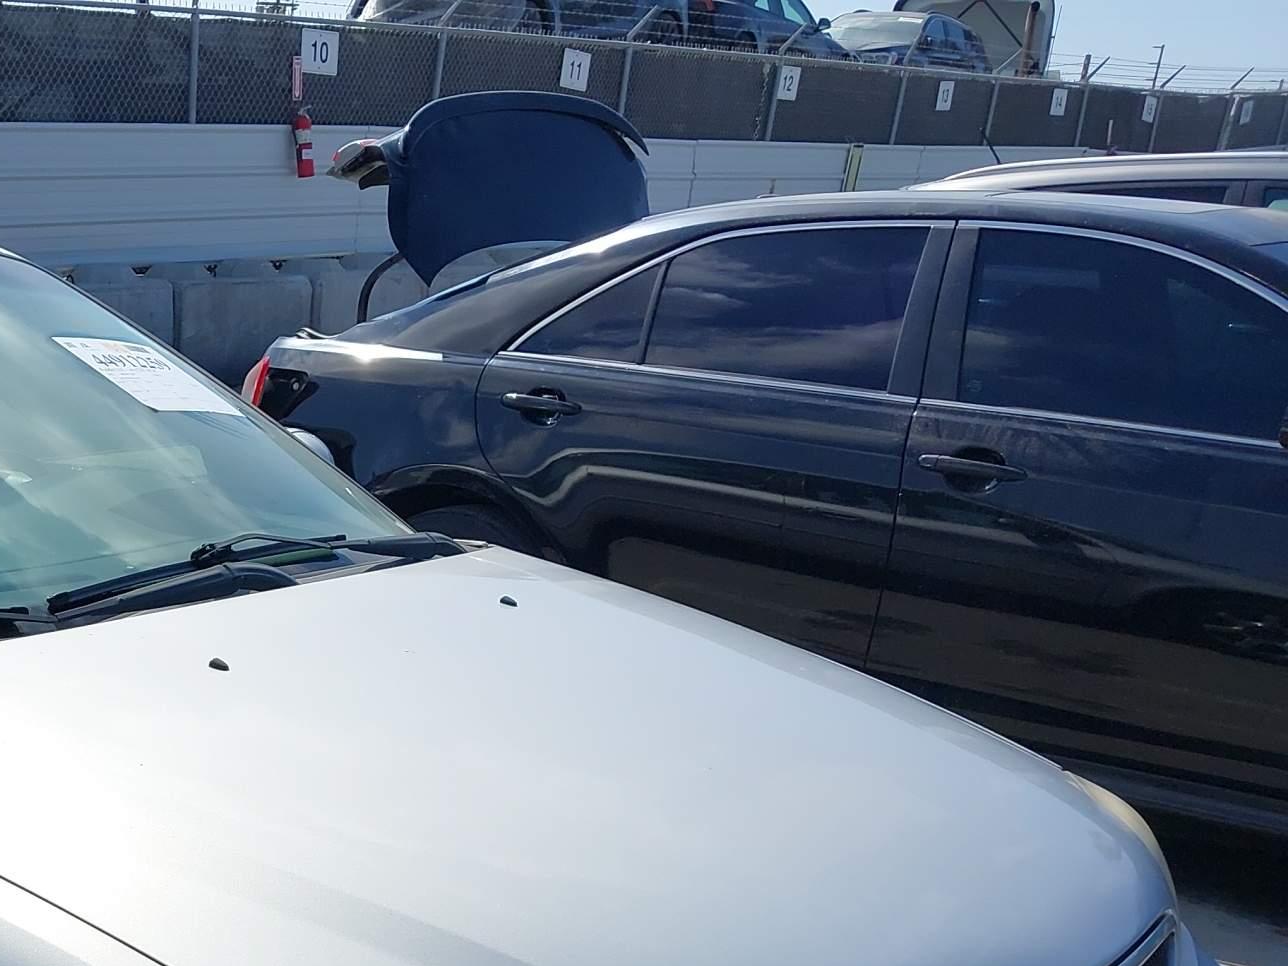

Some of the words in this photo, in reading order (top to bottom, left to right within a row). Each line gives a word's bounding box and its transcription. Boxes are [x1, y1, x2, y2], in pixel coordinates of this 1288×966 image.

[311, 39, 329, 63] 10
[570, 60, 583, 81] 11
[783, 75, 794, 92] 12
